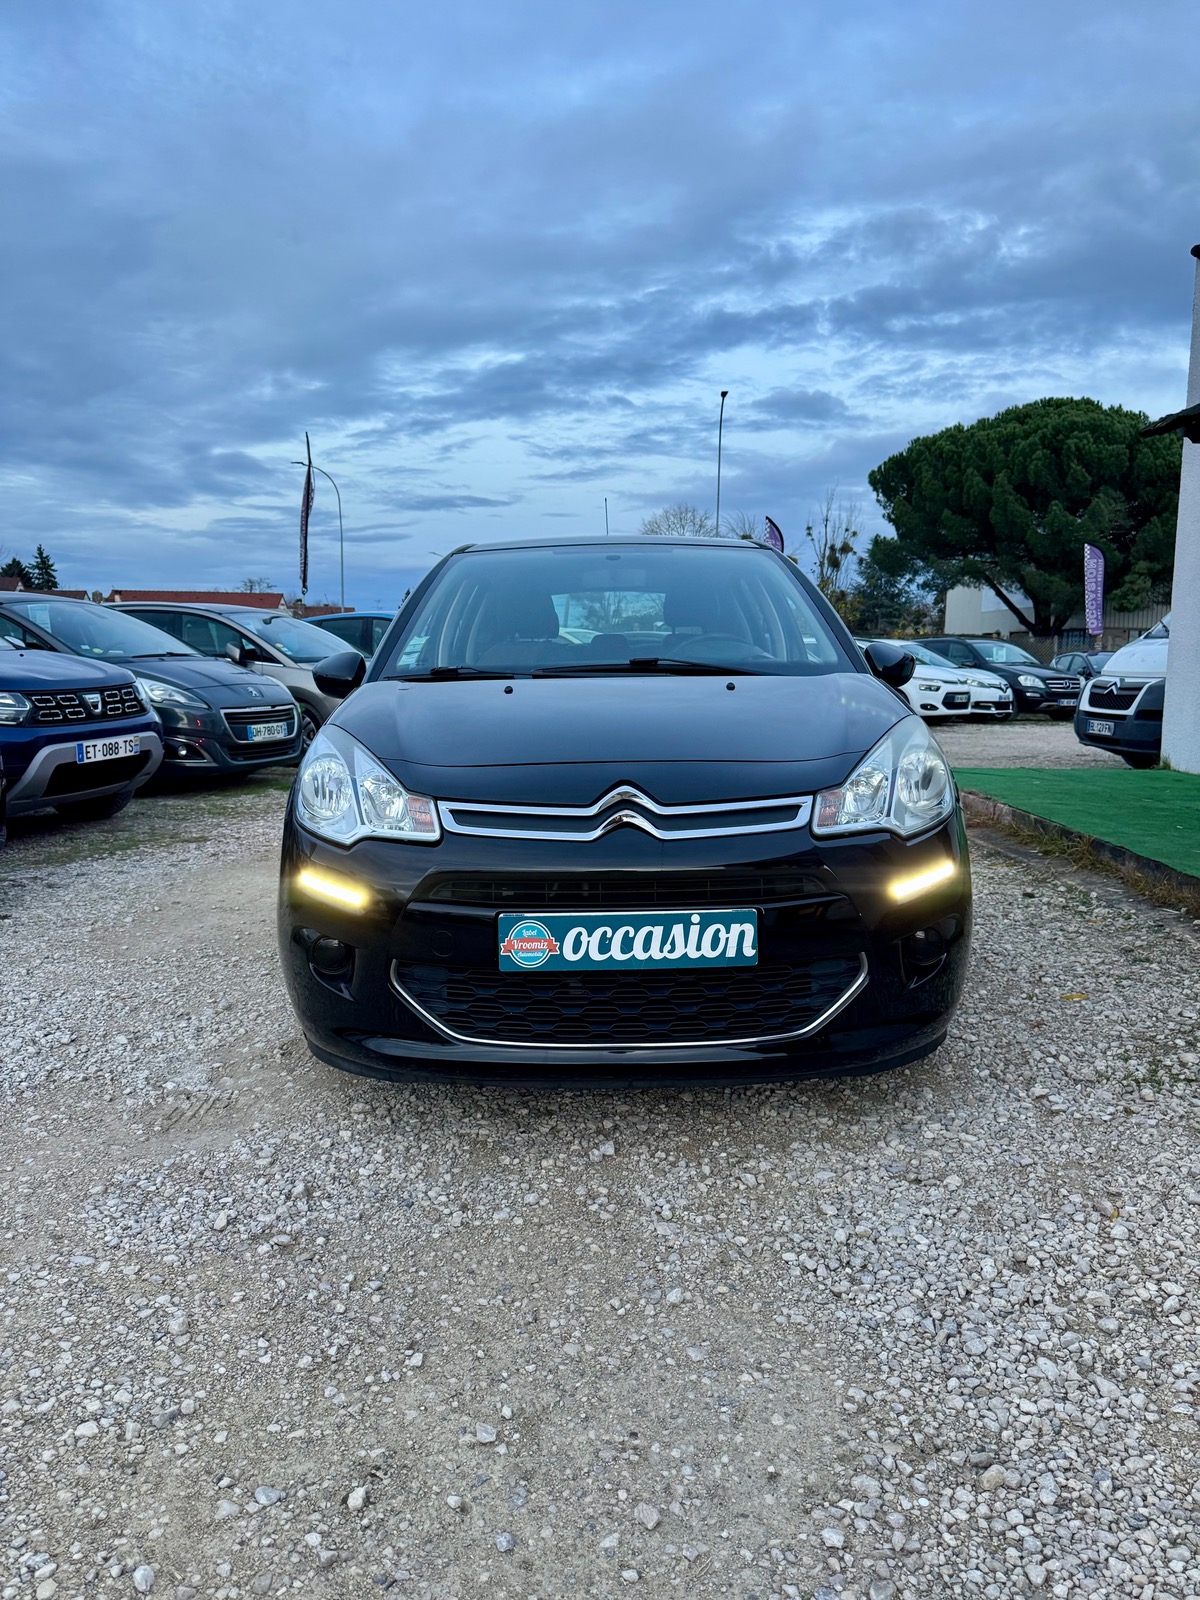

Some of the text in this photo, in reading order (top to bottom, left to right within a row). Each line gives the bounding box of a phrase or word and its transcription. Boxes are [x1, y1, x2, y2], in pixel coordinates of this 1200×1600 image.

[85, 739, 134, 760] ET-088-TS
[522, 929, 537, 938] Label
[562, 914, 757, 961] occasion
[511, 939, 549, 950] Vroomiz
